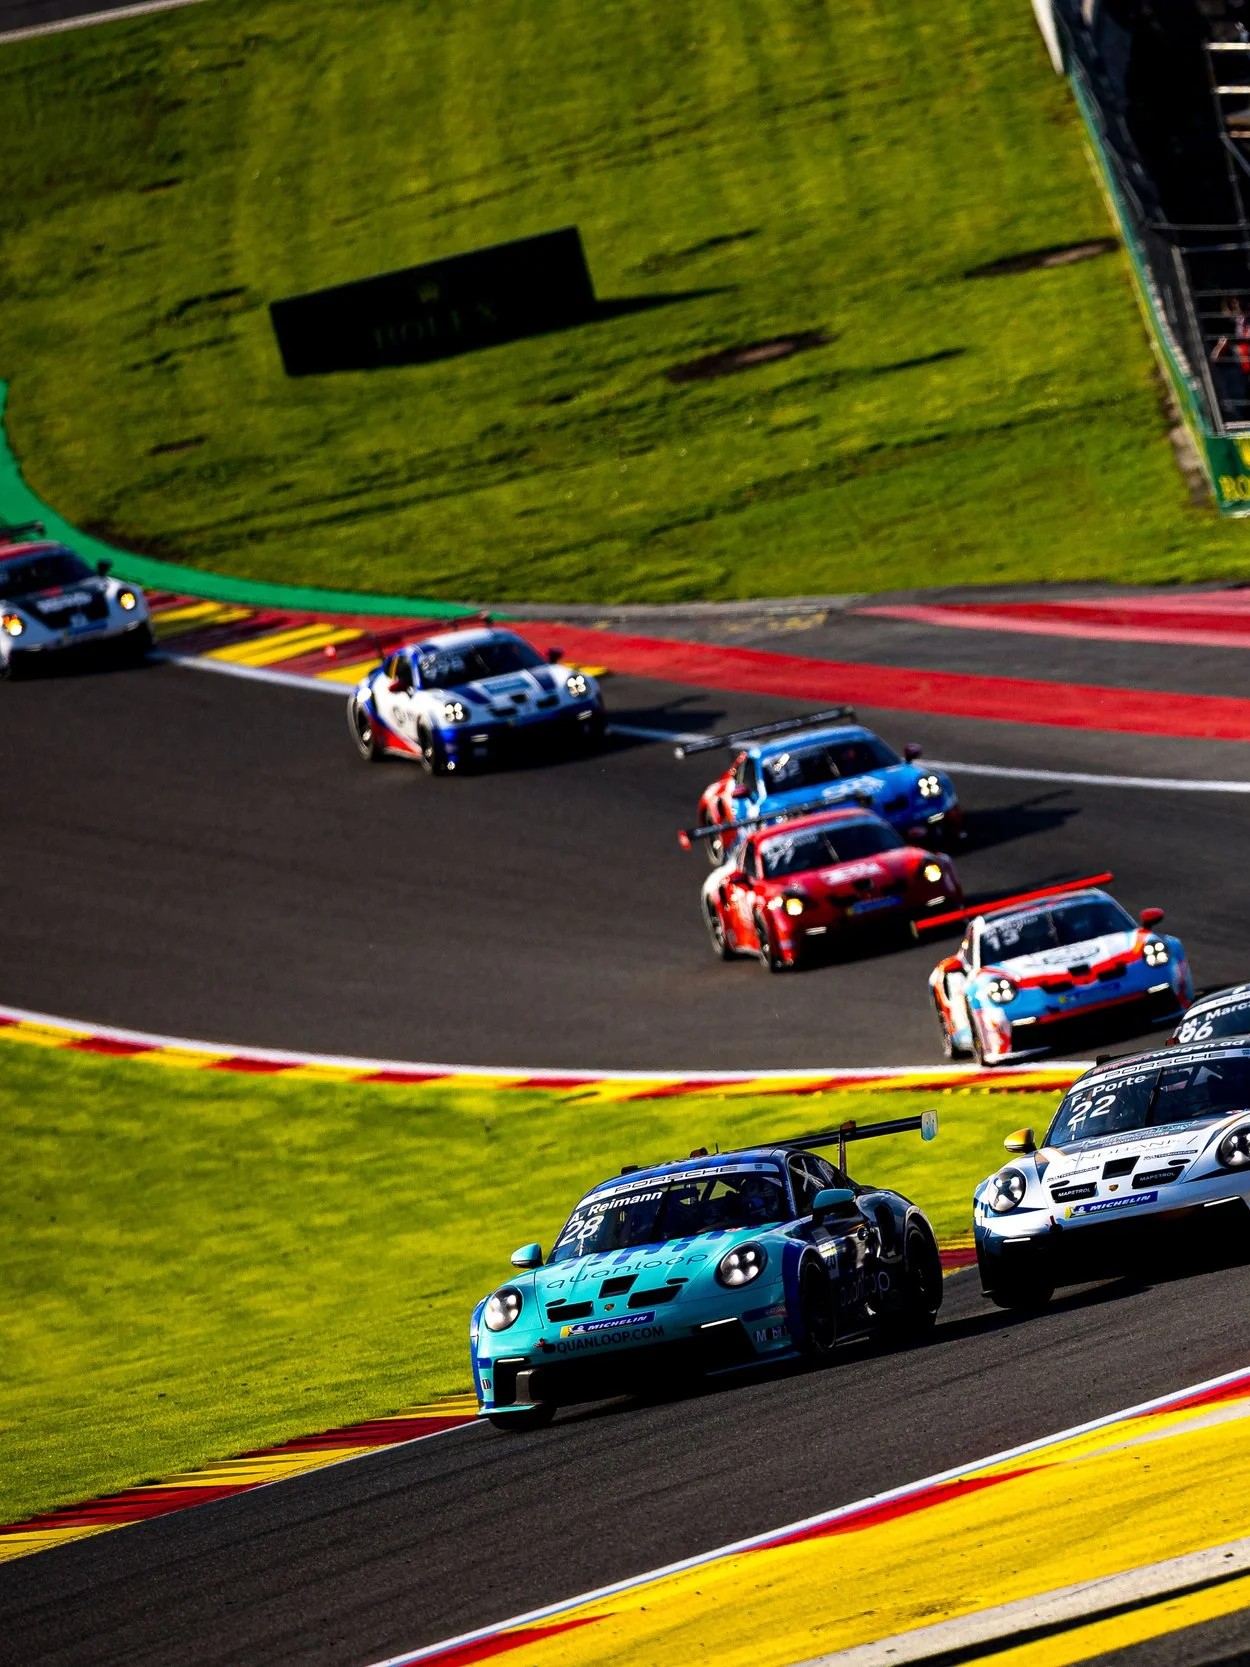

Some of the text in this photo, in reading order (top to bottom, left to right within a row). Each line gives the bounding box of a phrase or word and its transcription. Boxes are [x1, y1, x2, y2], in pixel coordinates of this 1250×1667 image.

[1104, 1050, 1226, 1079] PORSCHE
[1070, 1075, 1147, 1107] F. Porte
[1066, 1094, 1118, 1127] 22
[614, 1164, 739, 1194] PORSCHE
[1139, 1172, 1176, 1183] MAPETROL
[1057, 1187, 1093, 1198] MAPETROL
[1089, 1194, 1152, 1212] MICHELIN
[566, 1191, 664, 1227] A. Reimann
[557, 1215, 605, 1248] 28
[546, 1253, 709, 1289] quanloop
[587, 1315, 648, 1332] MICHELIN
[556, 1325, 666, 1354] QUANLOOP.COM
